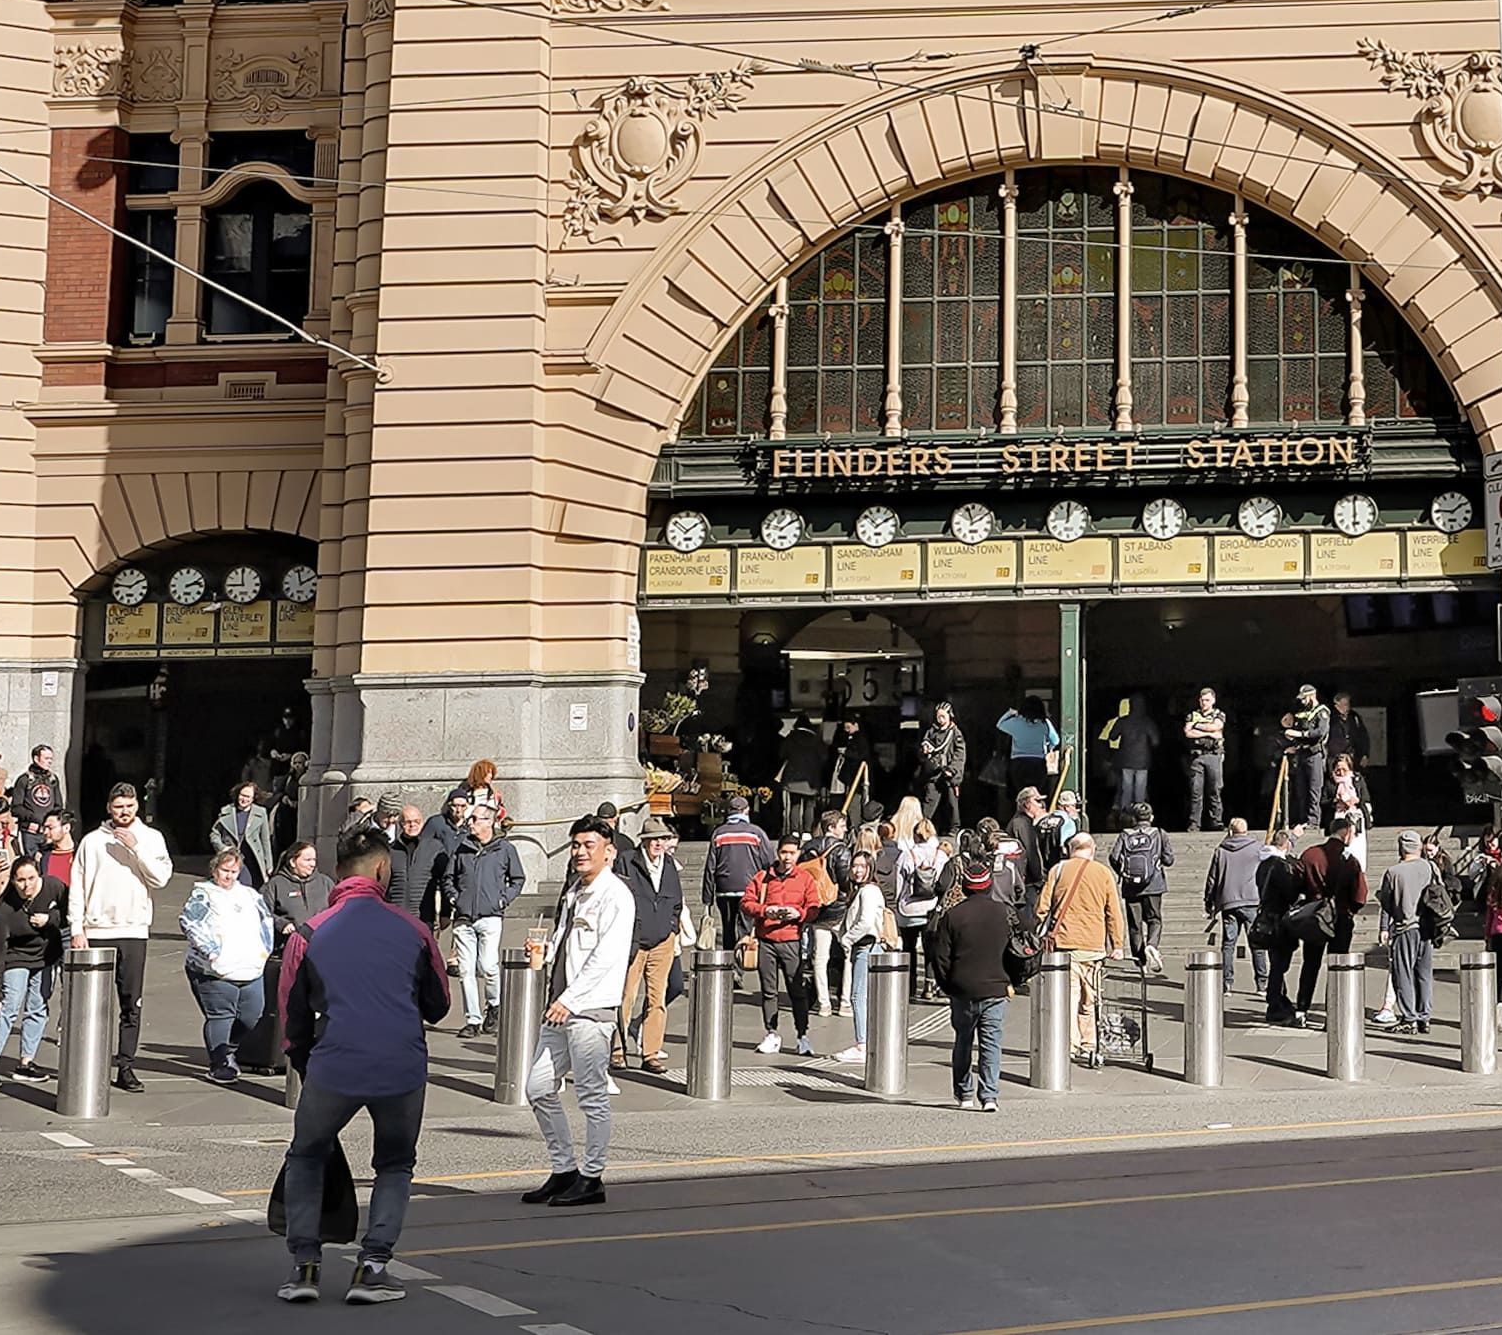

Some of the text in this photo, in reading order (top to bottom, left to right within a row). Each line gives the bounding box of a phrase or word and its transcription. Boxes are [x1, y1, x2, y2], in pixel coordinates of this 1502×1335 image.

[773, 435, 1355, 478] FLINDERS STREET STATION
[1220, 538, 1298, 549] BROADMEADOWS
[1316, 537, 1354, 547] UPFIELD
[1412, 535, 1459, 545] WERRIBEE
[933, 545, 1002, 556] WILLIAMSTOWN
[1029, 542, 1064, 552] ALTONA
[1124, 541, 1173, 551] ST ALBANS
[649, 553, 710, 563] PAKENHAM and
[740, 552, 794, 561] FRANKSTON
[837, 548, 903, 559] SANDRINGHAM
[1220, 553, 1240, 562] LINE
[1316, 550, 1336, 559] LINE
[1412, 548, 1433, 558] LINE
[933, 559, 953, 568] LINE
[1028, 556, 1048, 565] LINE
[1124, 555, 1144, 564] LINE
[649, 565, 728, 576] CRANBOURNE LINES
[740, 565, 760, 574] LINE
[837, 562, 857, 571] LINE
[222, 605, 244, 615] GLEN
[165, 615, 182, 625] LINE
[222, 614, 264, 623] WAVERLEY
